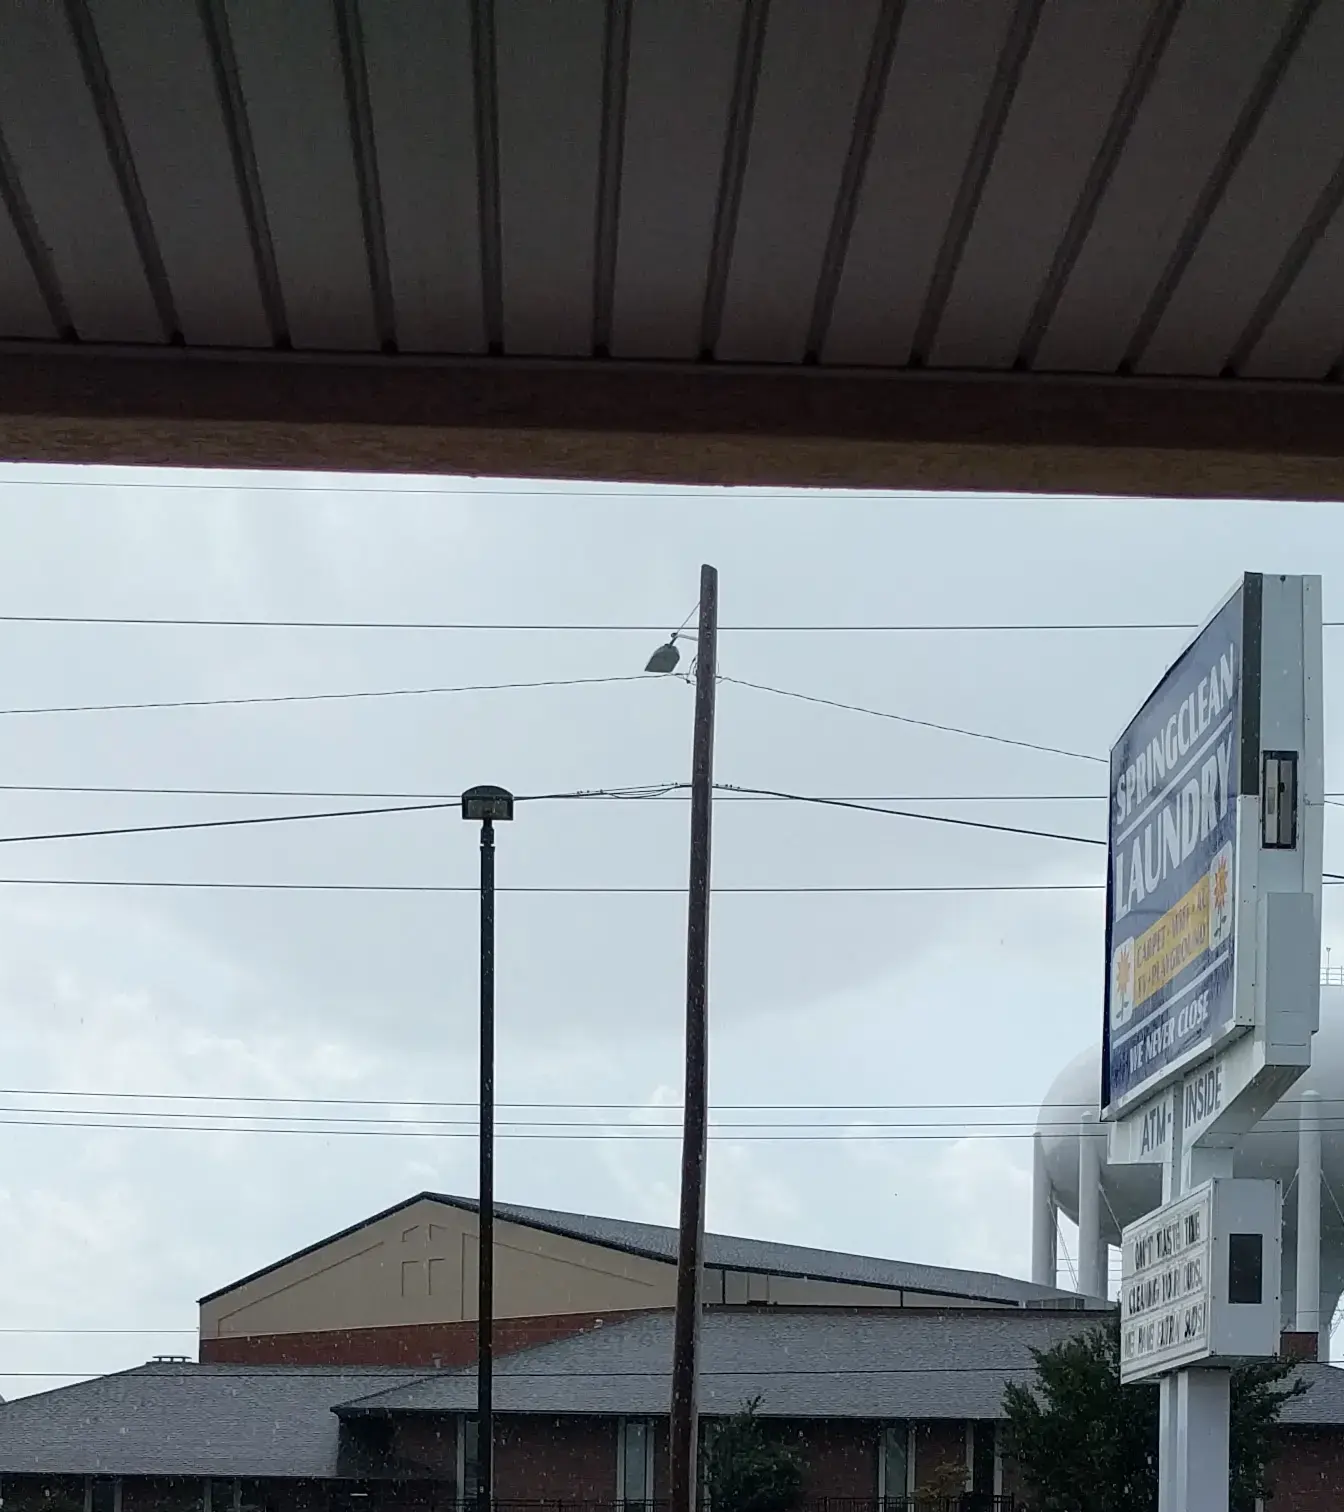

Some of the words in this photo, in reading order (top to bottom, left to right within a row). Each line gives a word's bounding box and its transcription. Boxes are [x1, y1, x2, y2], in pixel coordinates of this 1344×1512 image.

[1117, 643, 1234, 826] SPRINGCLEAN
[1115, 732, 1233, 923] LAUNDRY
[1136, 924, 1166, 969] CARPET
[1152, 924, 1205, 981] PLAYGROUND
[1129, 1041, 1143, 1074] WE
[1145, 1017, 1175, 1063] NEVER
[1177, 990, 1209, 1038] CLOSE
[1184, 1065, 1223, 1129] INSIDE
